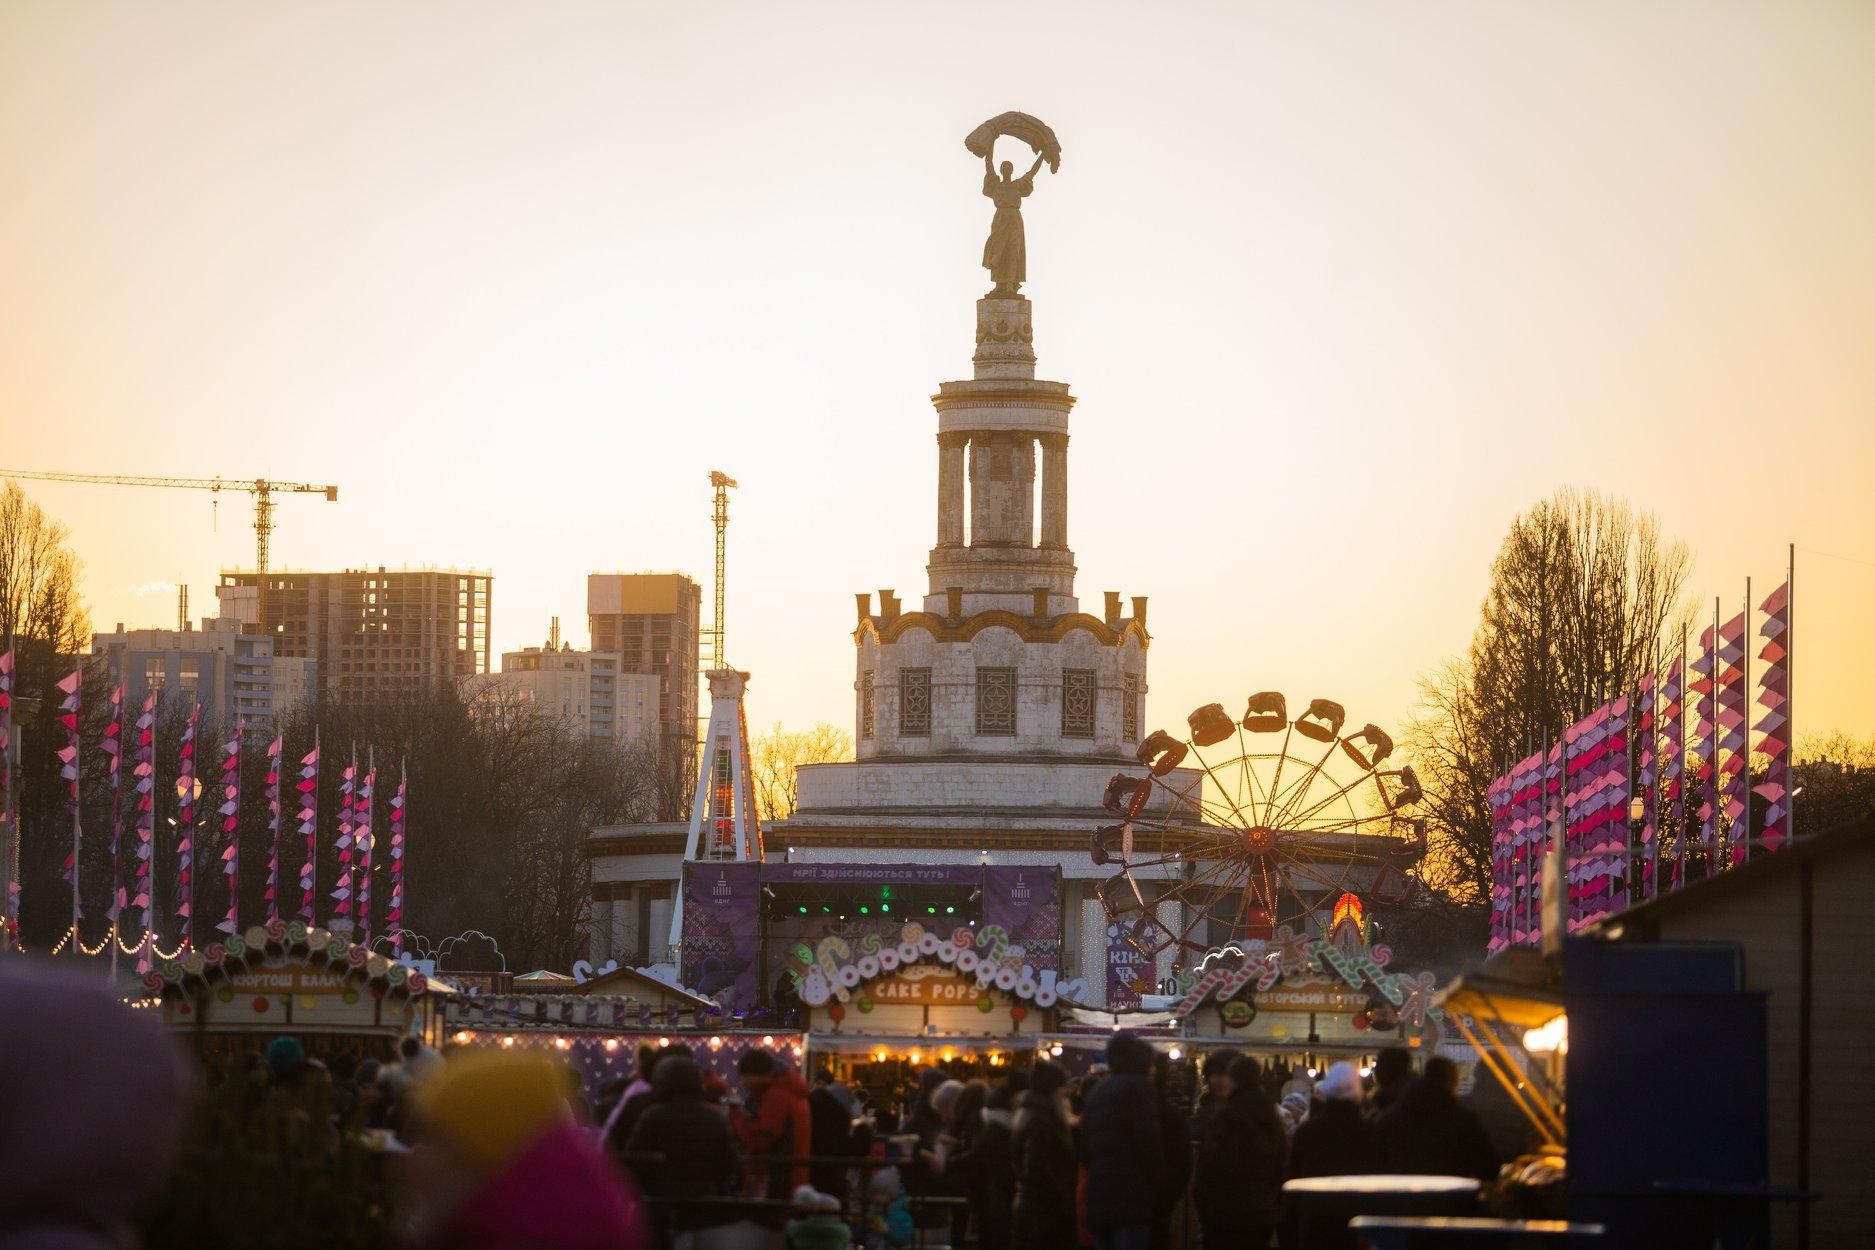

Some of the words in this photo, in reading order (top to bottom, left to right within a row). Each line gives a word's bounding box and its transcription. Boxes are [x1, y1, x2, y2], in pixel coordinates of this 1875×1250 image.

[793, 867, 817, 878] МРІЇ
[1110, 950, 1152, 964] КІН
[876, 983, 921, 998] CAKE
[932, 984, 979, 999] POPS
[1158, 978, 1177, 996] 10
